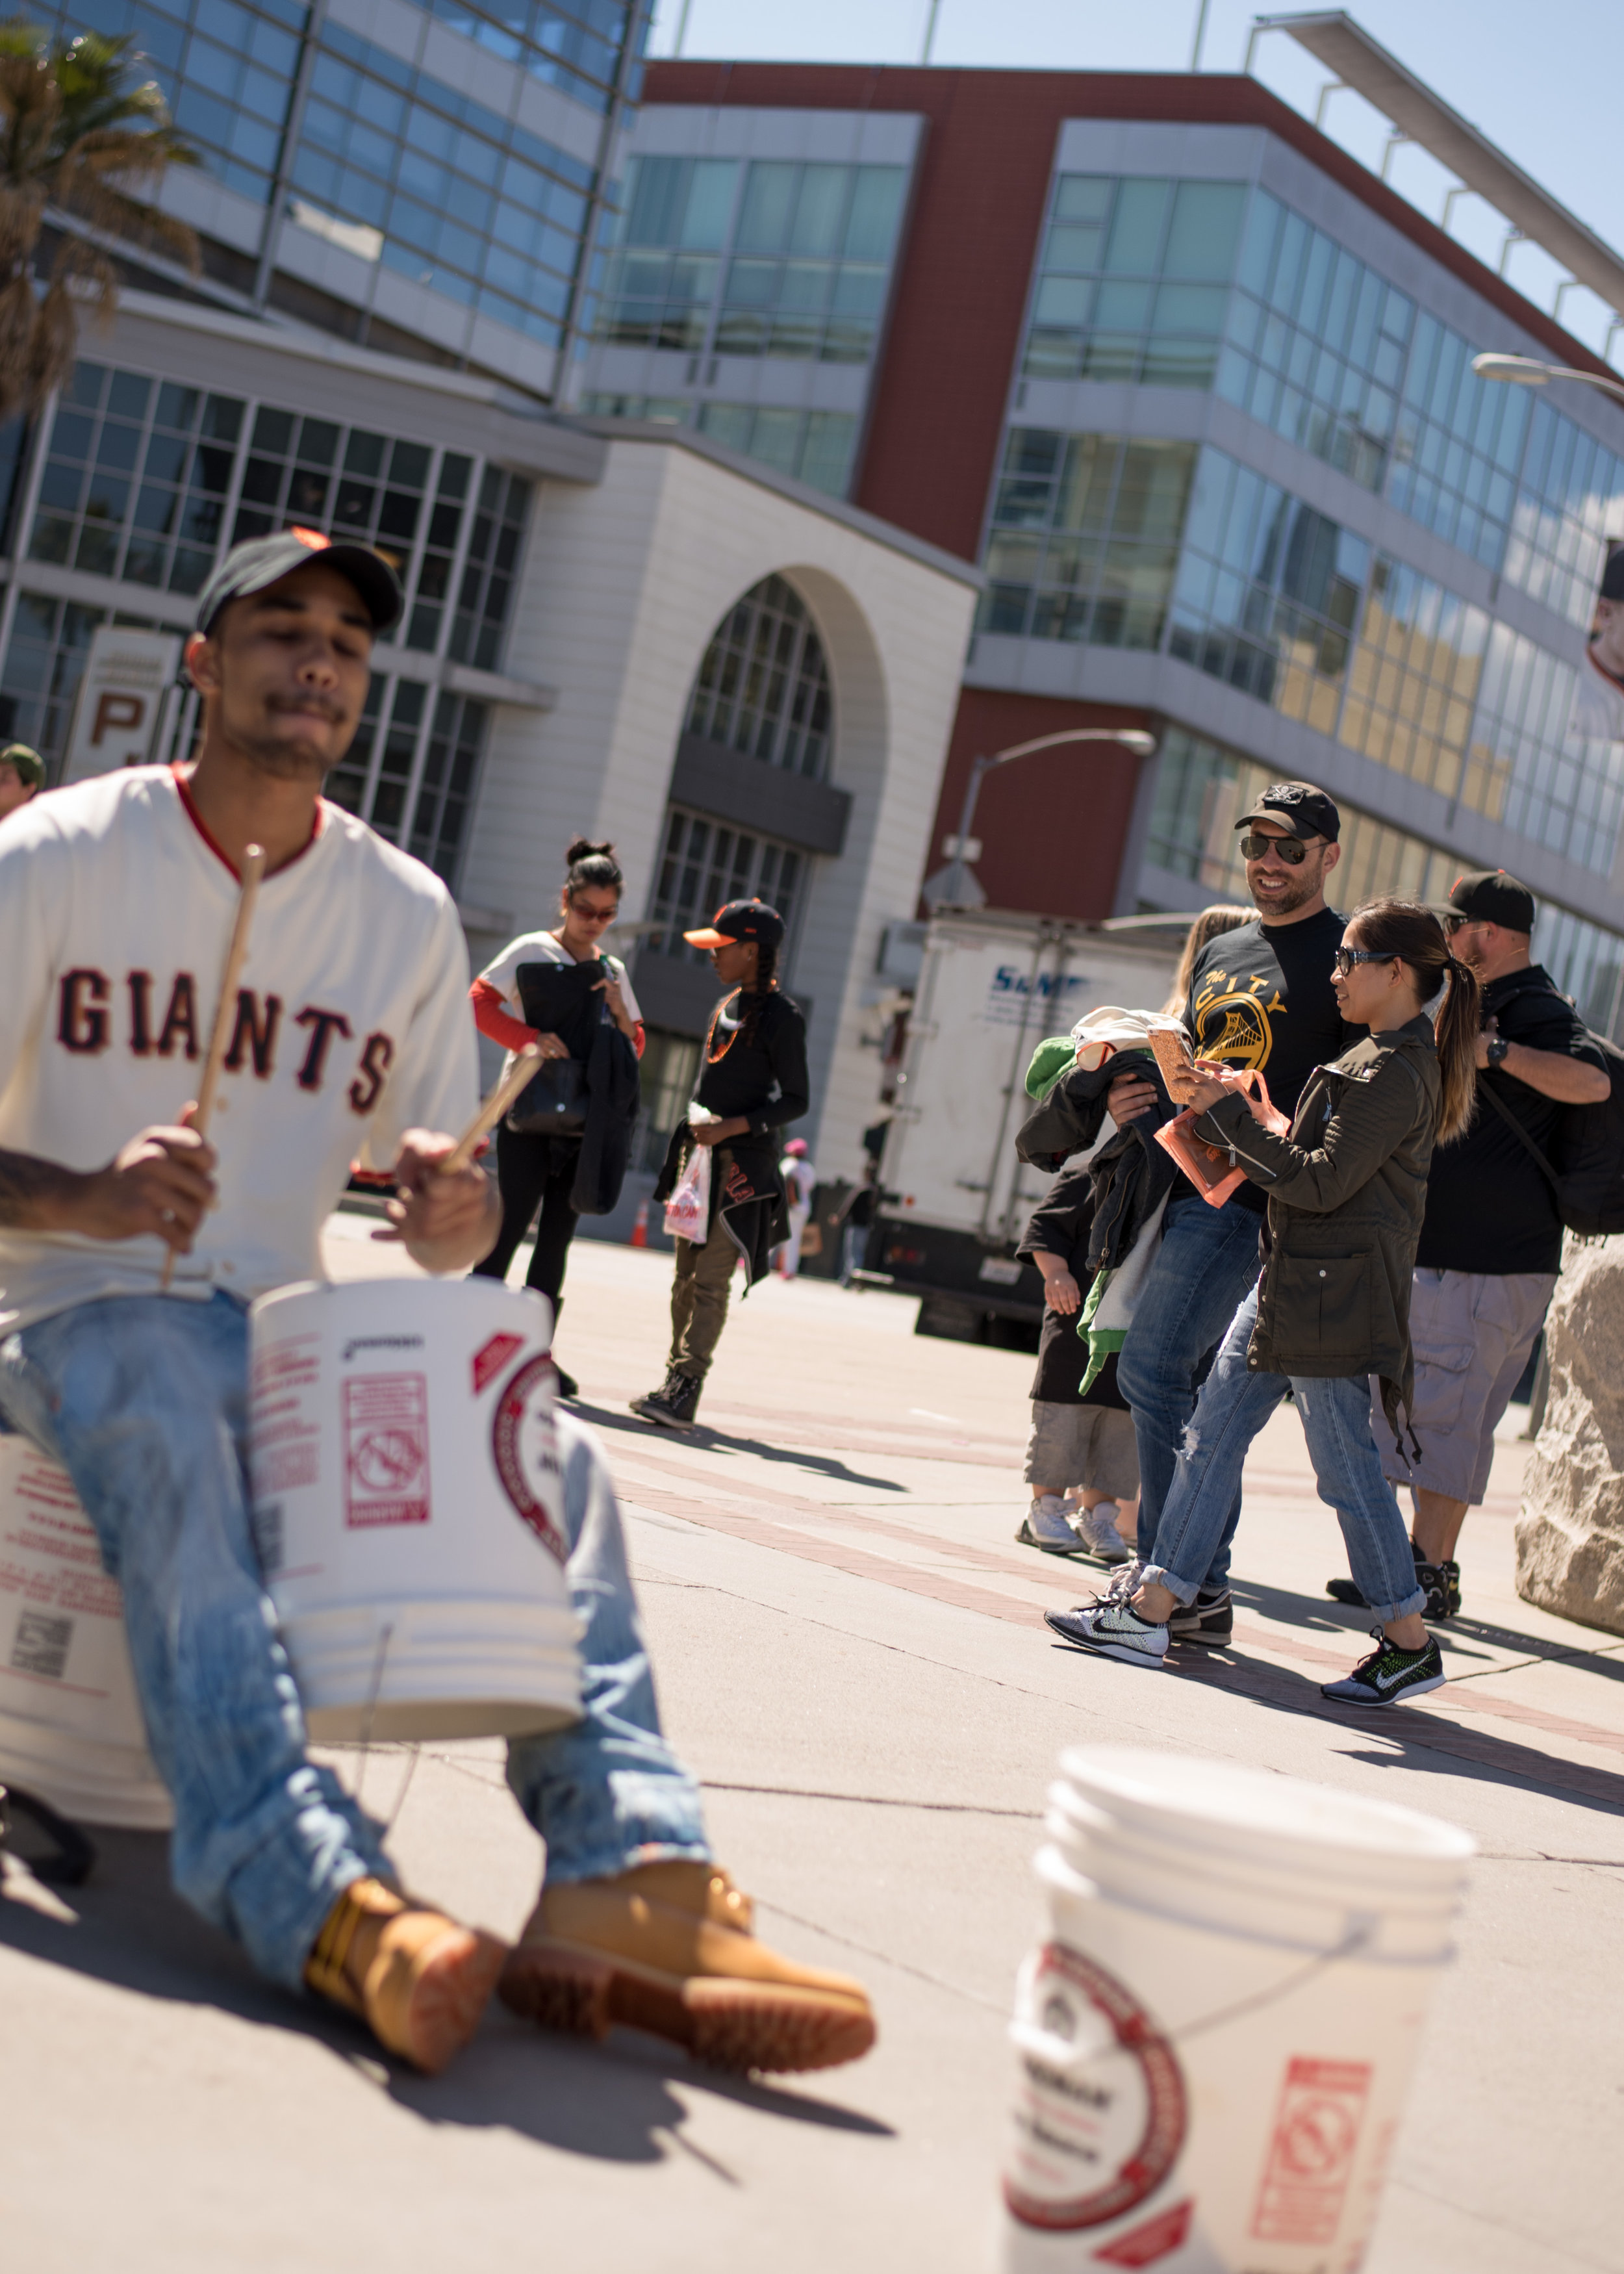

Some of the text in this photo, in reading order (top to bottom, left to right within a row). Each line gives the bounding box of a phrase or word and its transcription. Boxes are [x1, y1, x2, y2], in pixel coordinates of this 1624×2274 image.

[90, 693, 145, 747] P
[1195, 975, 1288, 1014] CITY
[1206, 969, 1226, 986] The
[58, 967, 395, 1115] GIANTS
